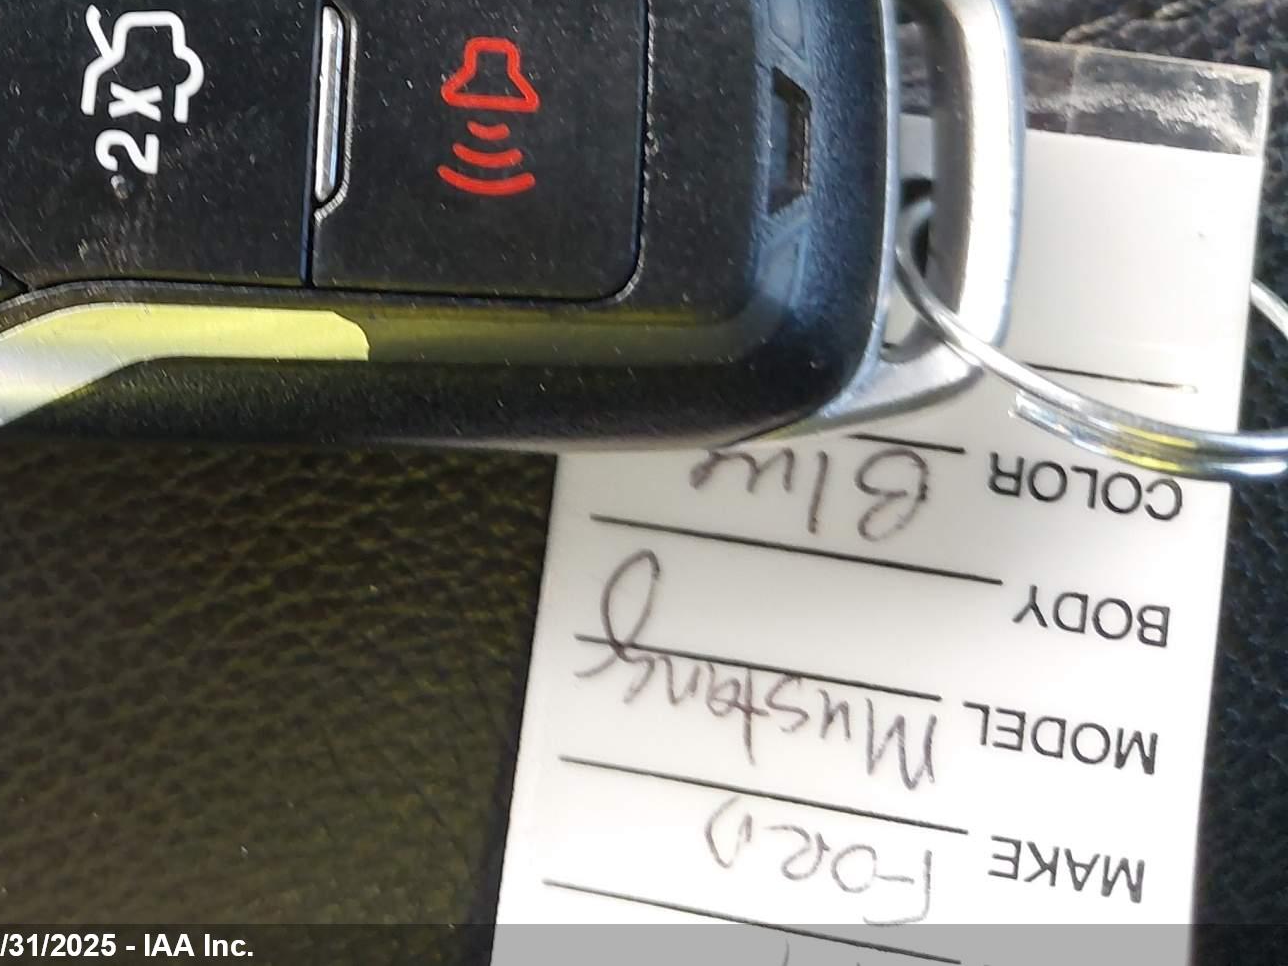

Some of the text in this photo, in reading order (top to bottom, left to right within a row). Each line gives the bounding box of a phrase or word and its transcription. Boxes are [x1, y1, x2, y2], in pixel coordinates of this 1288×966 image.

[690, 447, 929, 542] Blue
[990, 451, 1182, 522] COLOR
[1012, 584, 1171, 647] BODY
[575, 549, 937, 789] Mustang
[963, 701, 1158, 775] MODEL
[988, 835, 1145, 903] MAKE
